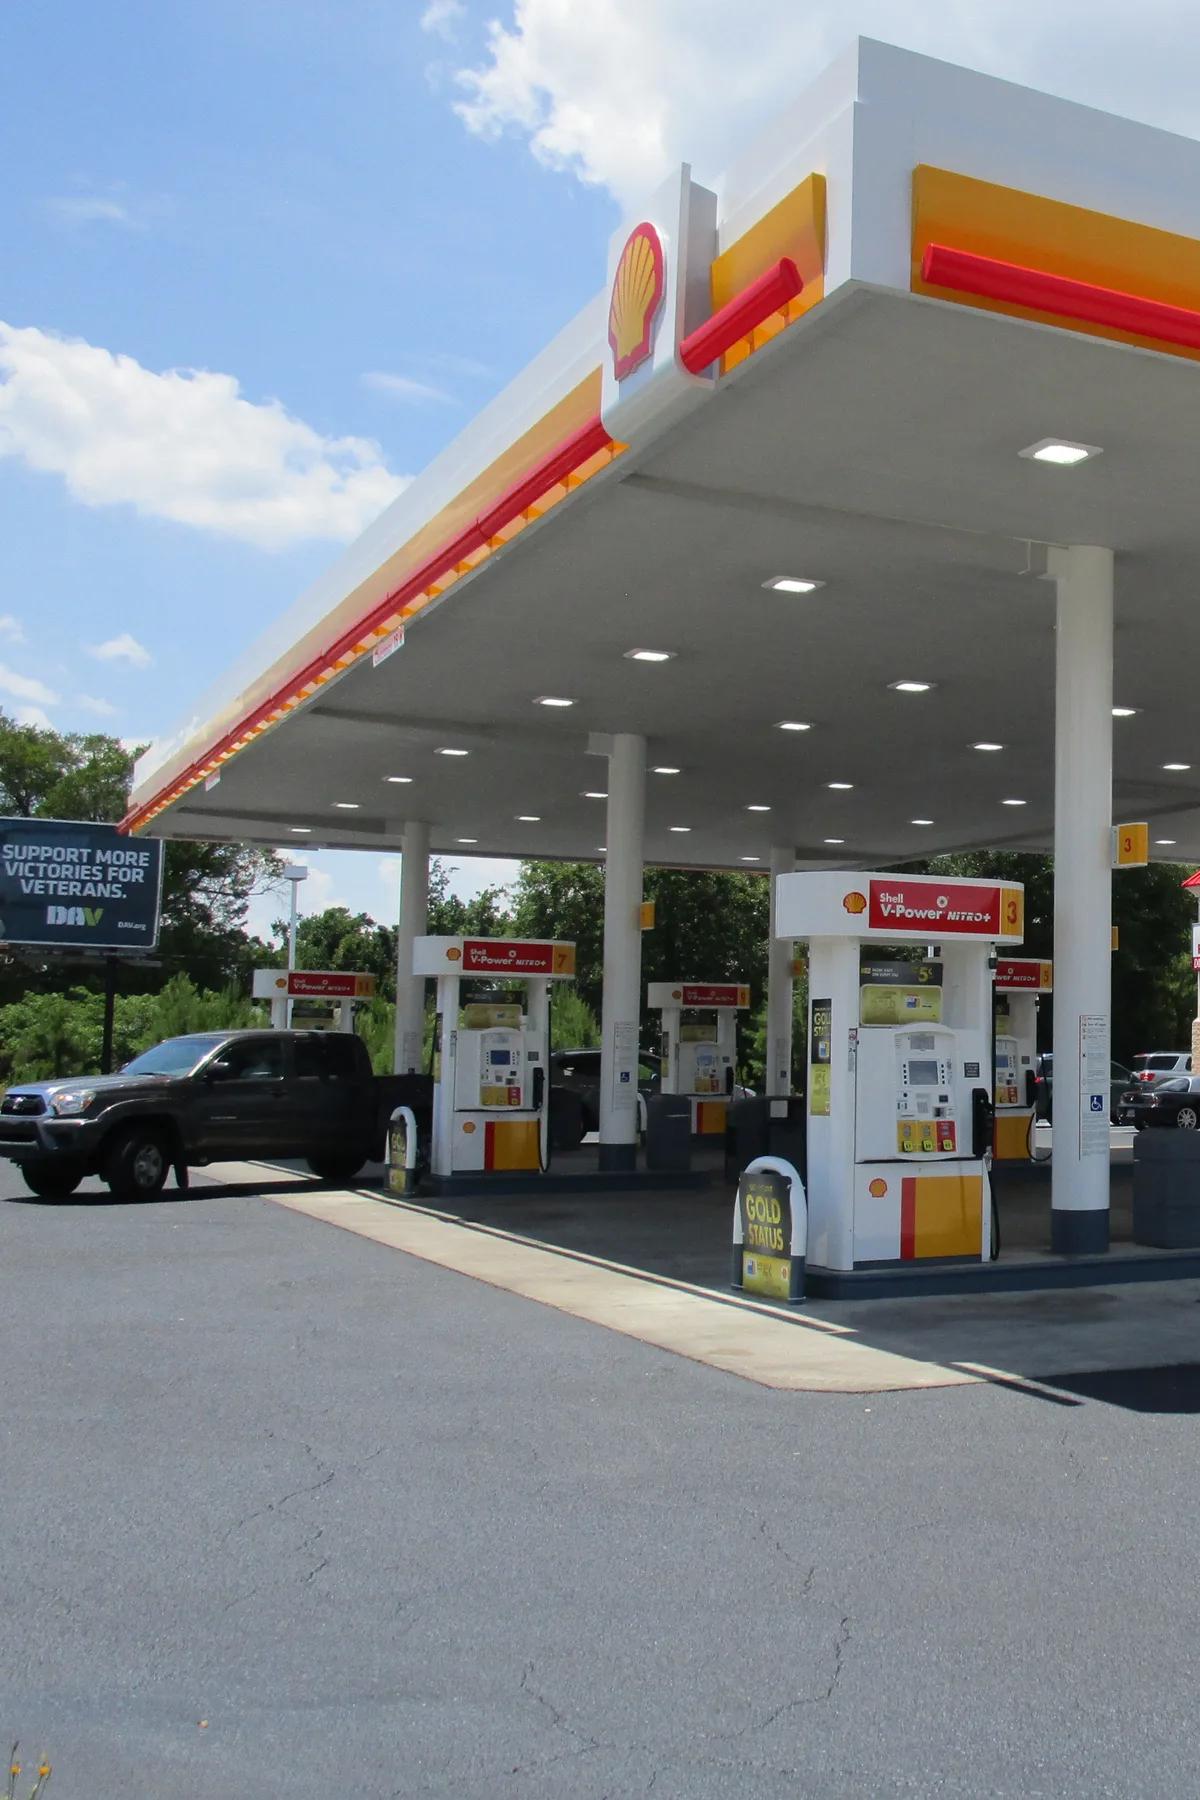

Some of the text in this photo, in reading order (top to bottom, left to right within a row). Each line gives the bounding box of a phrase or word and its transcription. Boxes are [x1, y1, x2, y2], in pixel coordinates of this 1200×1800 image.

[1124, 837, 1132, 852] 3
[2, 844, 150, 867] SUPPORT MORE
[4, 861, 144, 883] VICTORIES FOR
[20, 879, 127, 898] VETERANS.
[880, 893, 904, 904] Shell
[47, 905, 104, 927] DAV
[880, 904, 943, 920] V-Power
[1007, 901, 1018, 924] 3
[117, 921, 147, 931] DAV.org
[470, 955, 513, 965] V-Power
[558, 953, 568, 969] 7
[745, 1194, 782, 1224] GOLD
[748, 1223, 784, 1251] STATUS
